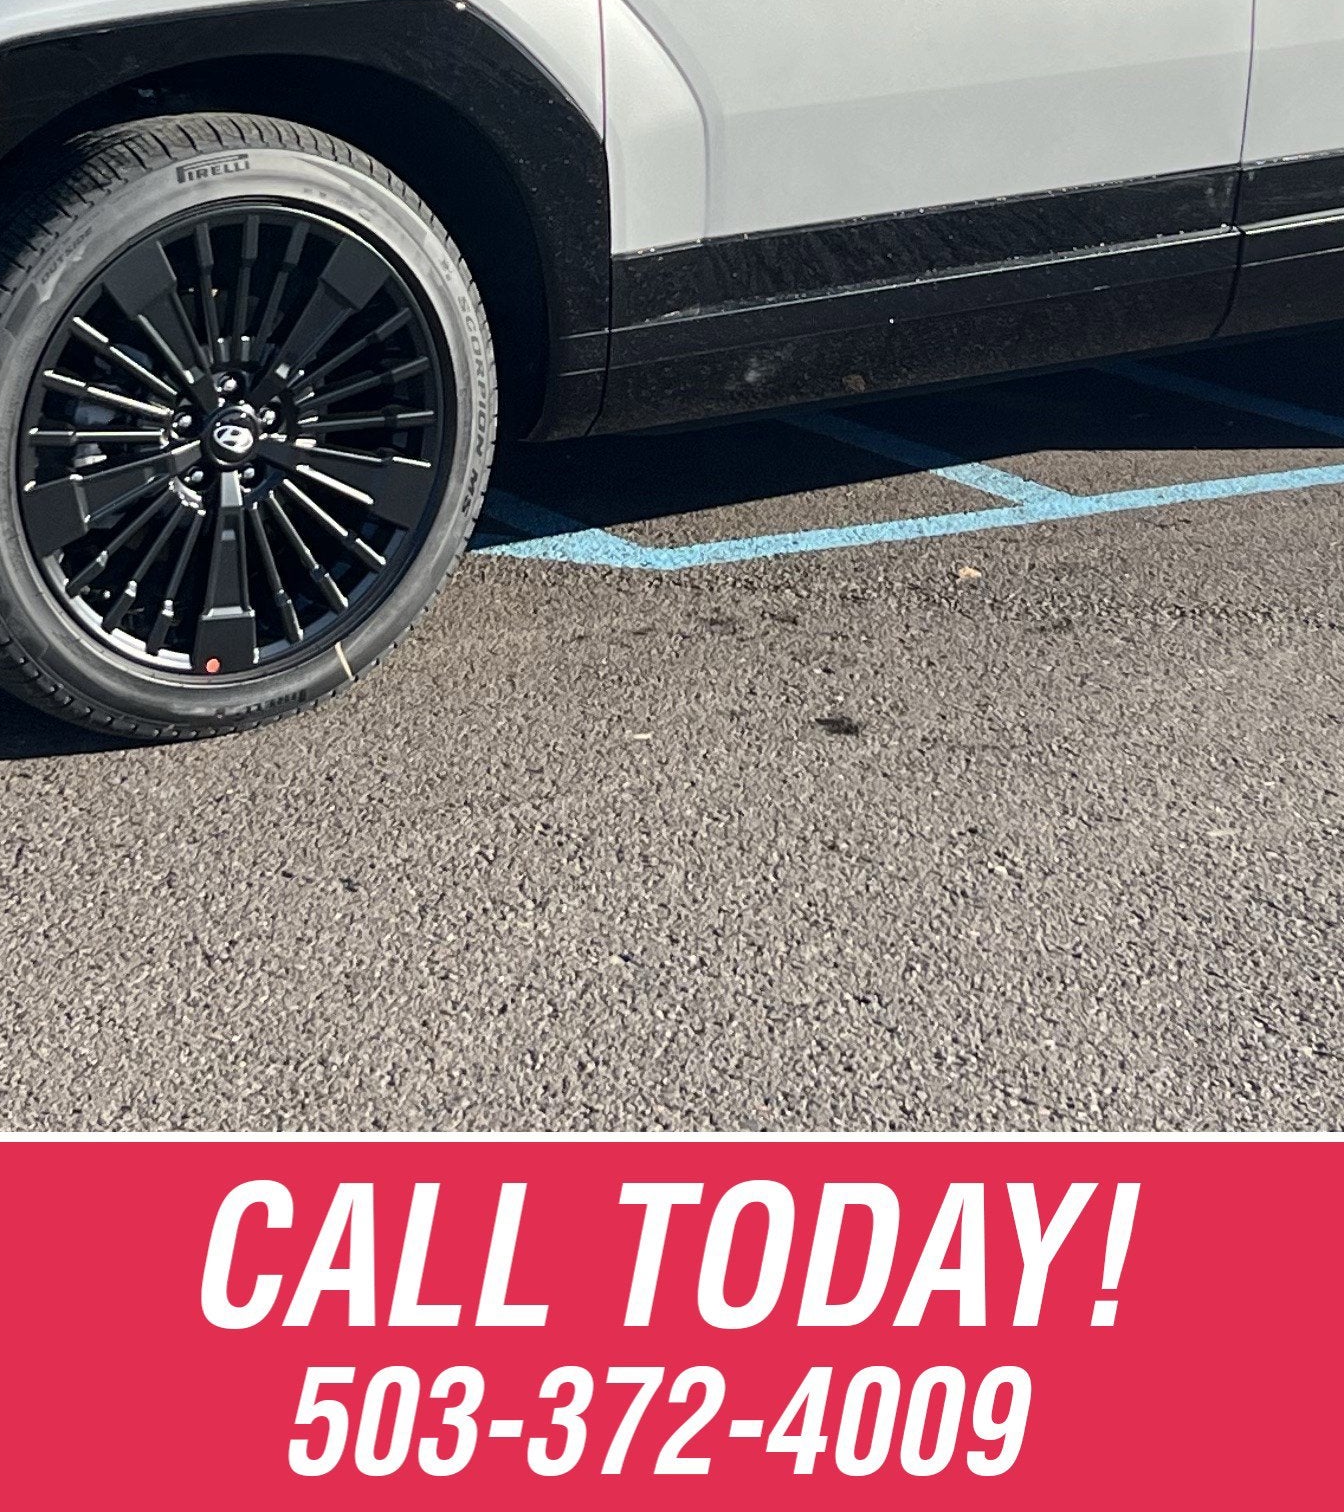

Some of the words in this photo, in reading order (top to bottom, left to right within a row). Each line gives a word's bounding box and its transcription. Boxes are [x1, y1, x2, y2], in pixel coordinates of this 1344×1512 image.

[176, 154, 250, 183] PIRELLI
[457, 295, 488, 457] SCORPION
[461, 468, 479, 517] MS
